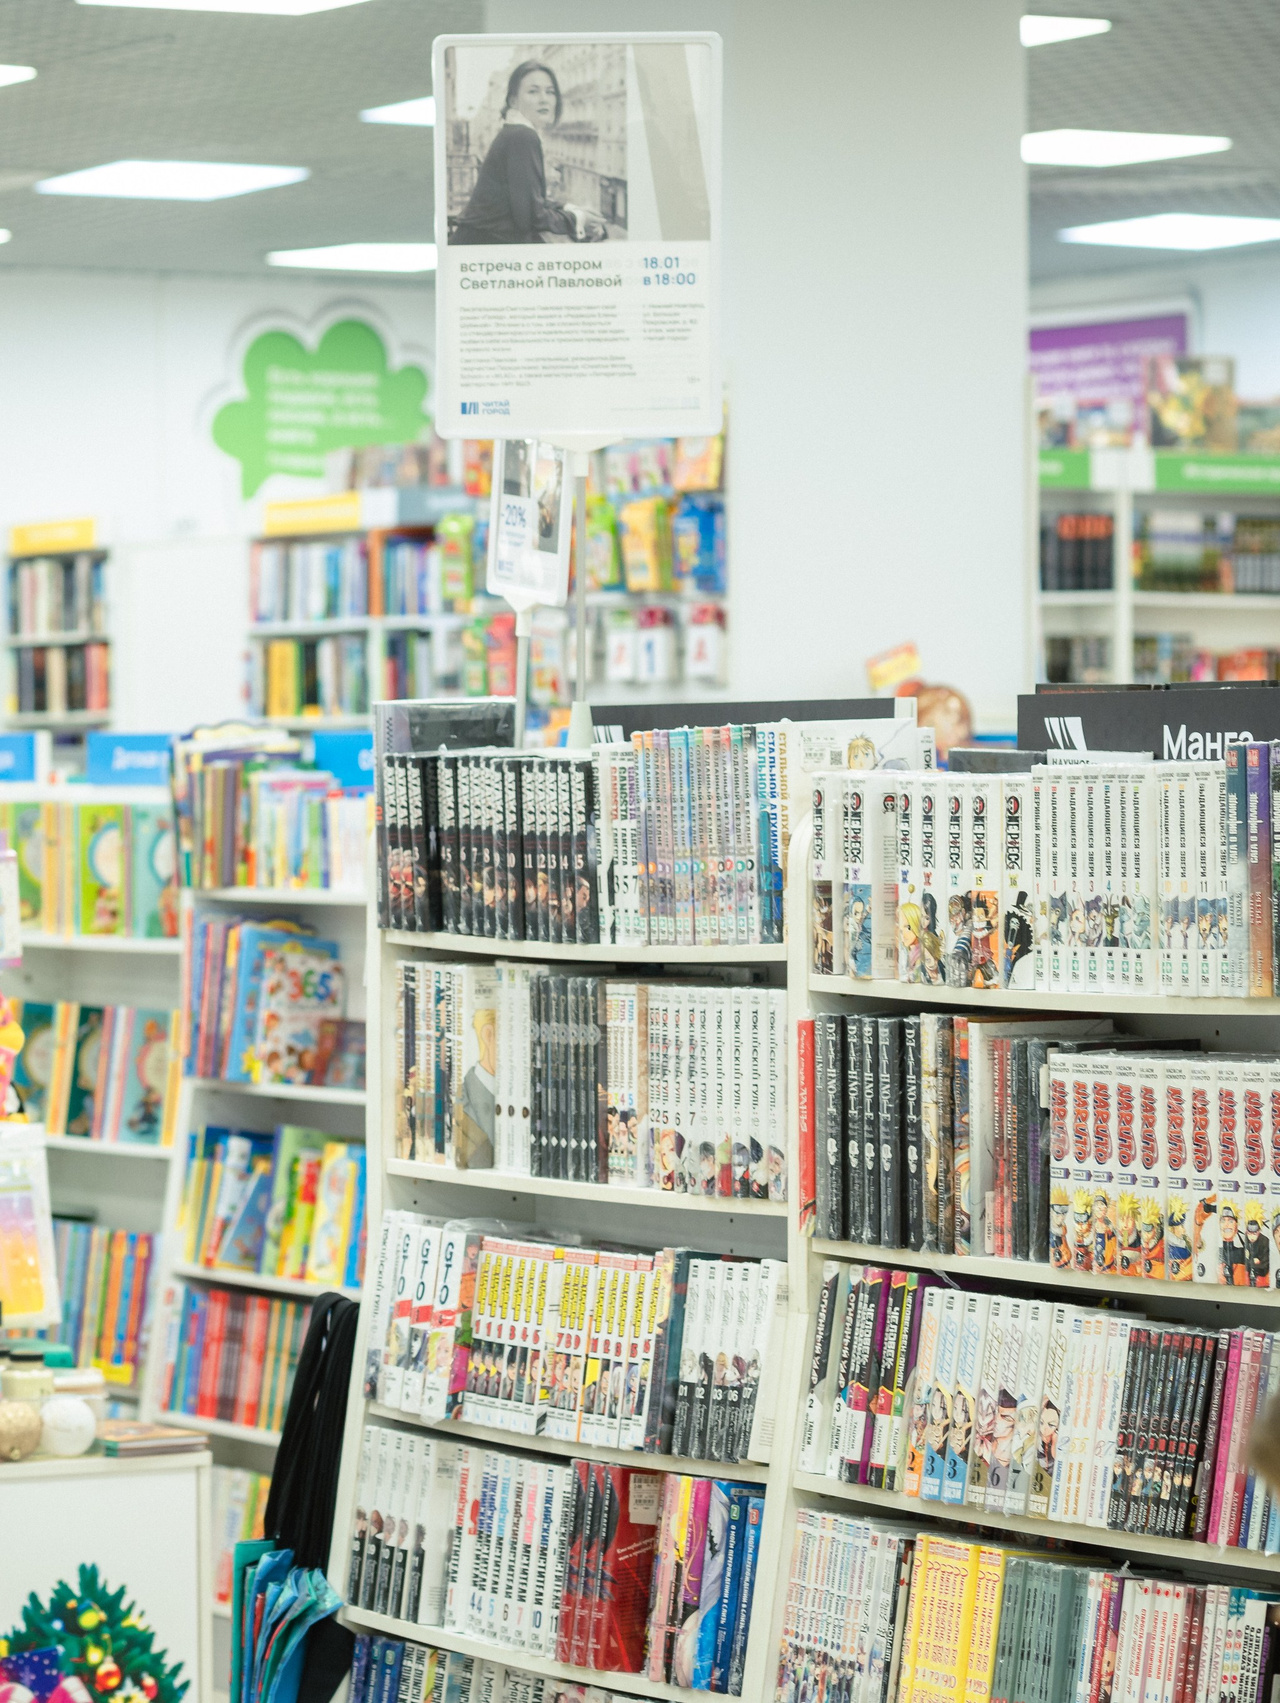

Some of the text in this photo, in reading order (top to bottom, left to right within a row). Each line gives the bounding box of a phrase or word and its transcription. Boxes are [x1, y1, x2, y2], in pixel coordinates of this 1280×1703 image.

[460, 260, 602, 275] встреча с автором
[460, 275, 622, 289] Светланой Павловой
[643, 257, 680, 269] 18.01
[643, 273, 696, 286] в 18:00
[482, 400, 510, 408] ЧИТАЙ
[768, 731, 779, 799] СТАЛЬНОЙ
[779, 732, 790, 801] СТАЛЬНОЙ
[288, 970, 331, 1002] 365
[675, 1112, 681, 1126] 6
[690, 1112, 696, 1126] 7
[1051, 1080, 1069, 1161] NARUTO
[1073, 1080, 1091, 1164] NARUTO
[1093, 1081, 1112, 1165] NARUTO
[1117, 1083, 1137, 1167] NARUTO
[1140, 1085, 1159, 1170] NARUTO
[1167, 1086, 1187, 1173] NARUTO
[1192, 1087, 1212, 1173] NARUTO
[1220, 1088, 1239, 1174] NARUTO
[1244, 1089, 1265, 1176] NARUTO
[397, 1234, 411, 1296] GTO
[416, 1239, 431, 1301] GTO
[439, 1242, 454, 1305] GTO
[811, 1289, 829, 1385] ОГНЕННЫЙ УДАР
[838, 1293, 856, 1389] ОГНЕННЫЙ УДАР
[695, 1386, 705, 1399] 02
[808, 1399, 814, 1408] 2
[835, 1402, 841, 1413] 3
[806, 1421, 814, 1445] ТАЦУКИ
[834, 1425, 842, 1450] ТАЦУКИ
[926, 1455, 935, 1476] 3
[948, 1458, 957, 1479] 3
[991, 1465, 1001, 1486] 6
[1228, 1490, 1239, 1538] АДАТИТОКА
[1239, 1493, 1250, 1540] АДАТИТОКА
[502, 1603, 509, 1622] 6
[884, 1623, 895, 1662] ШЕРЛОК
[1176, 1615, 1190, 1692] MARS RED
[1185, 1617, 1200, 1694] MARS RED
